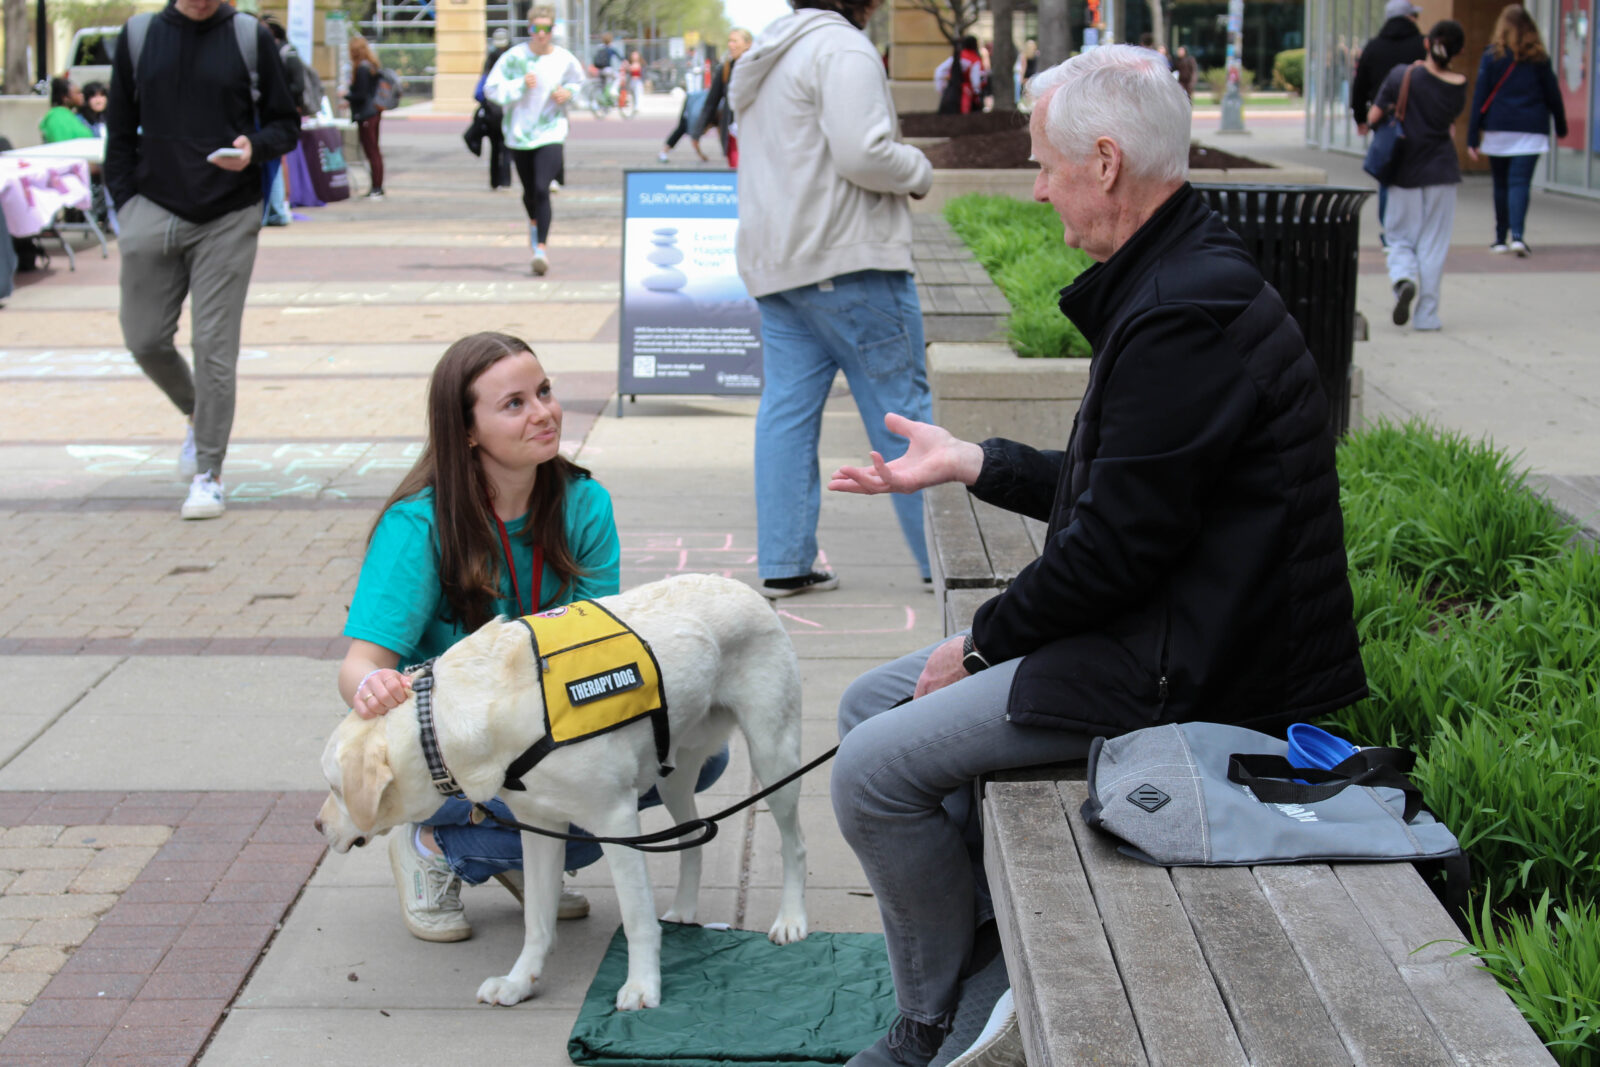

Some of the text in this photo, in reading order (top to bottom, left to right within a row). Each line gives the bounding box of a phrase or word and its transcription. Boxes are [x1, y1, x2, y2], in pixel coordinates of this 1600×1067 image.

[640, 193, 699, 205] SURVIVOR
[569, 668, 637, 701] THERAPY DOG
